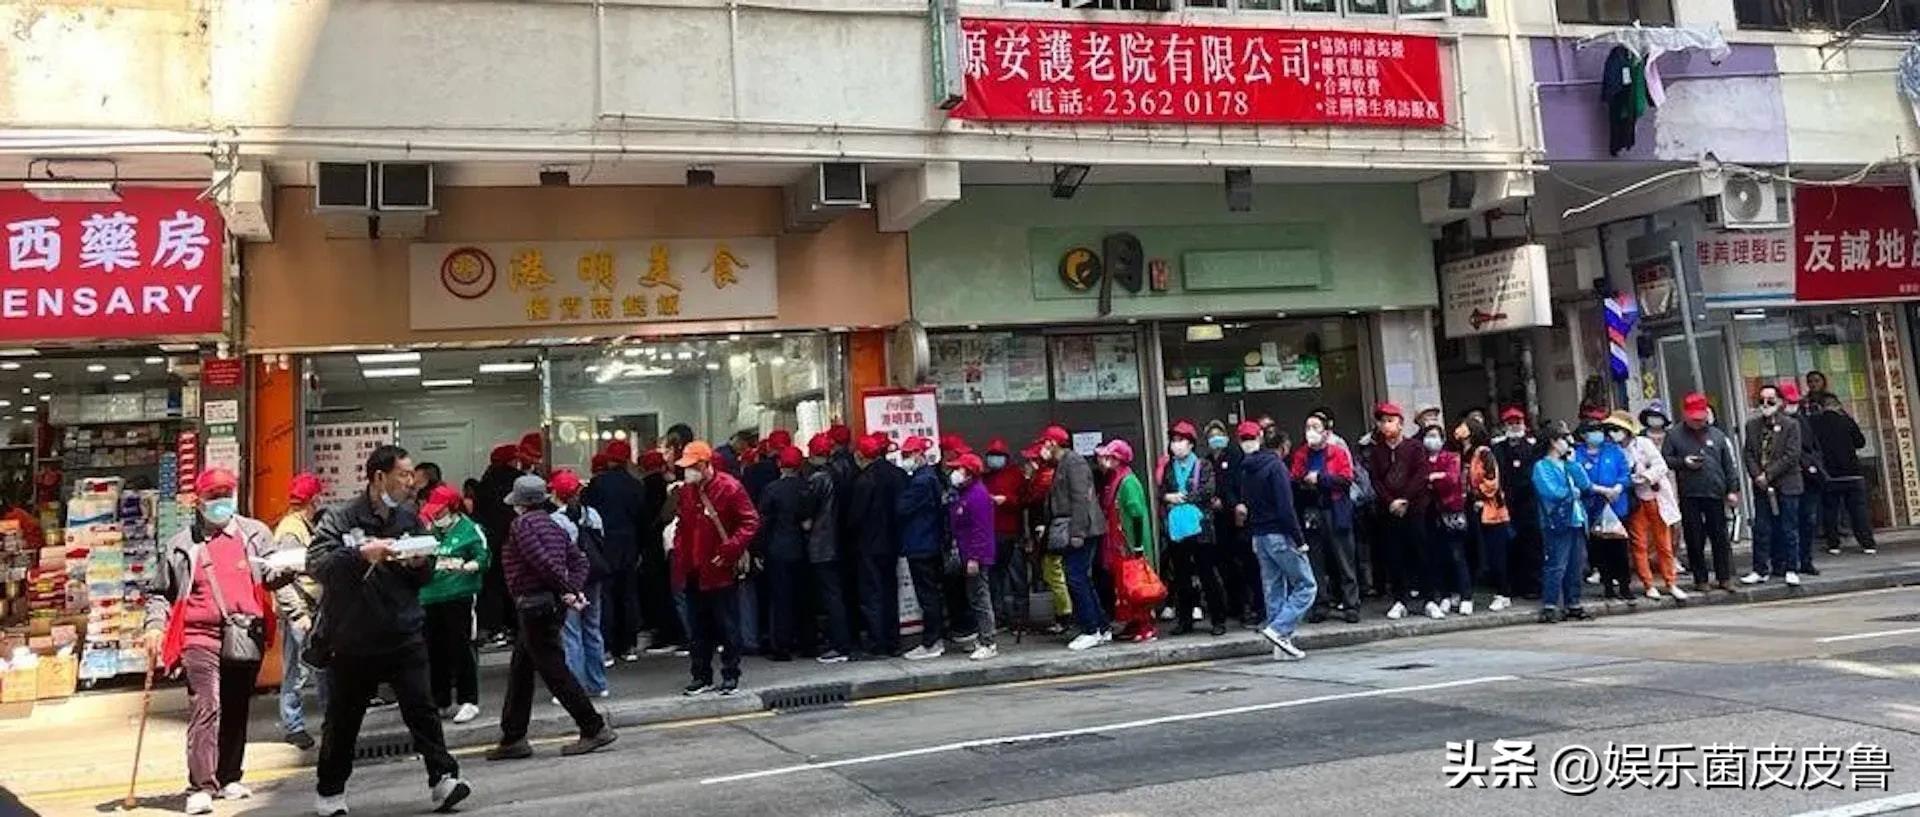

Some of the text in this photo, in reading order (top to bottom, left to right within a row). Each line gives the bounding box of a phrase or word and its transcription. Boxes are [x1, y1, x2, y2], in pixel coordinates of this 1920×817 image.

[1103, 90, 1174, 116] 2362
[1184, 91, 1249, 116] 0178
[6, 210, 210, 272] 西藥房
[3, 284, 202, 318] ENSARY
